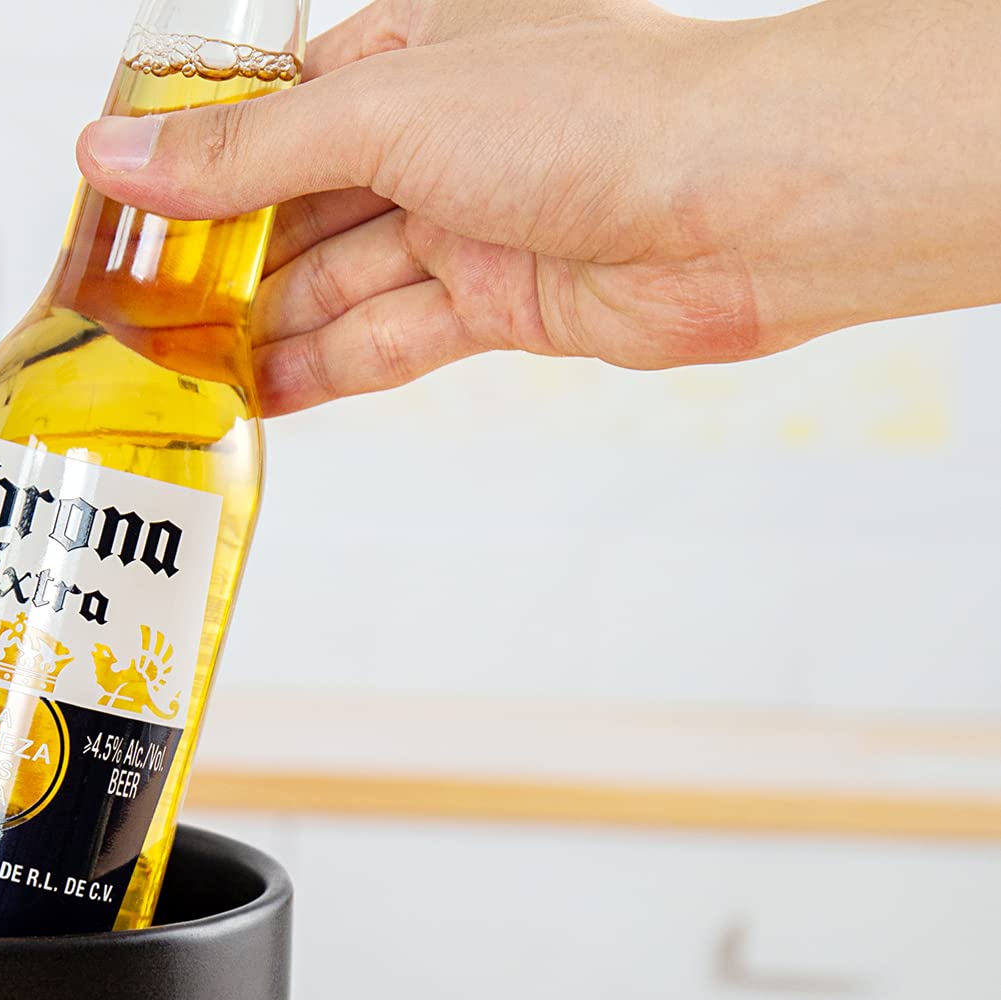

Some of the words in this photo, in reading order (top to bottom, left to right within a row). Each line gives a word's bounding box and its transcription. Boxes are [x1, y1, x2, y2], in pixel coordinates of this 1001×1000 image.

[107, 767, 141, 799] BEER
[25, 867, 58, 892] R.L.
[63, 876, 87, 898] DE
[88, 881, 114, 903] C.V.
